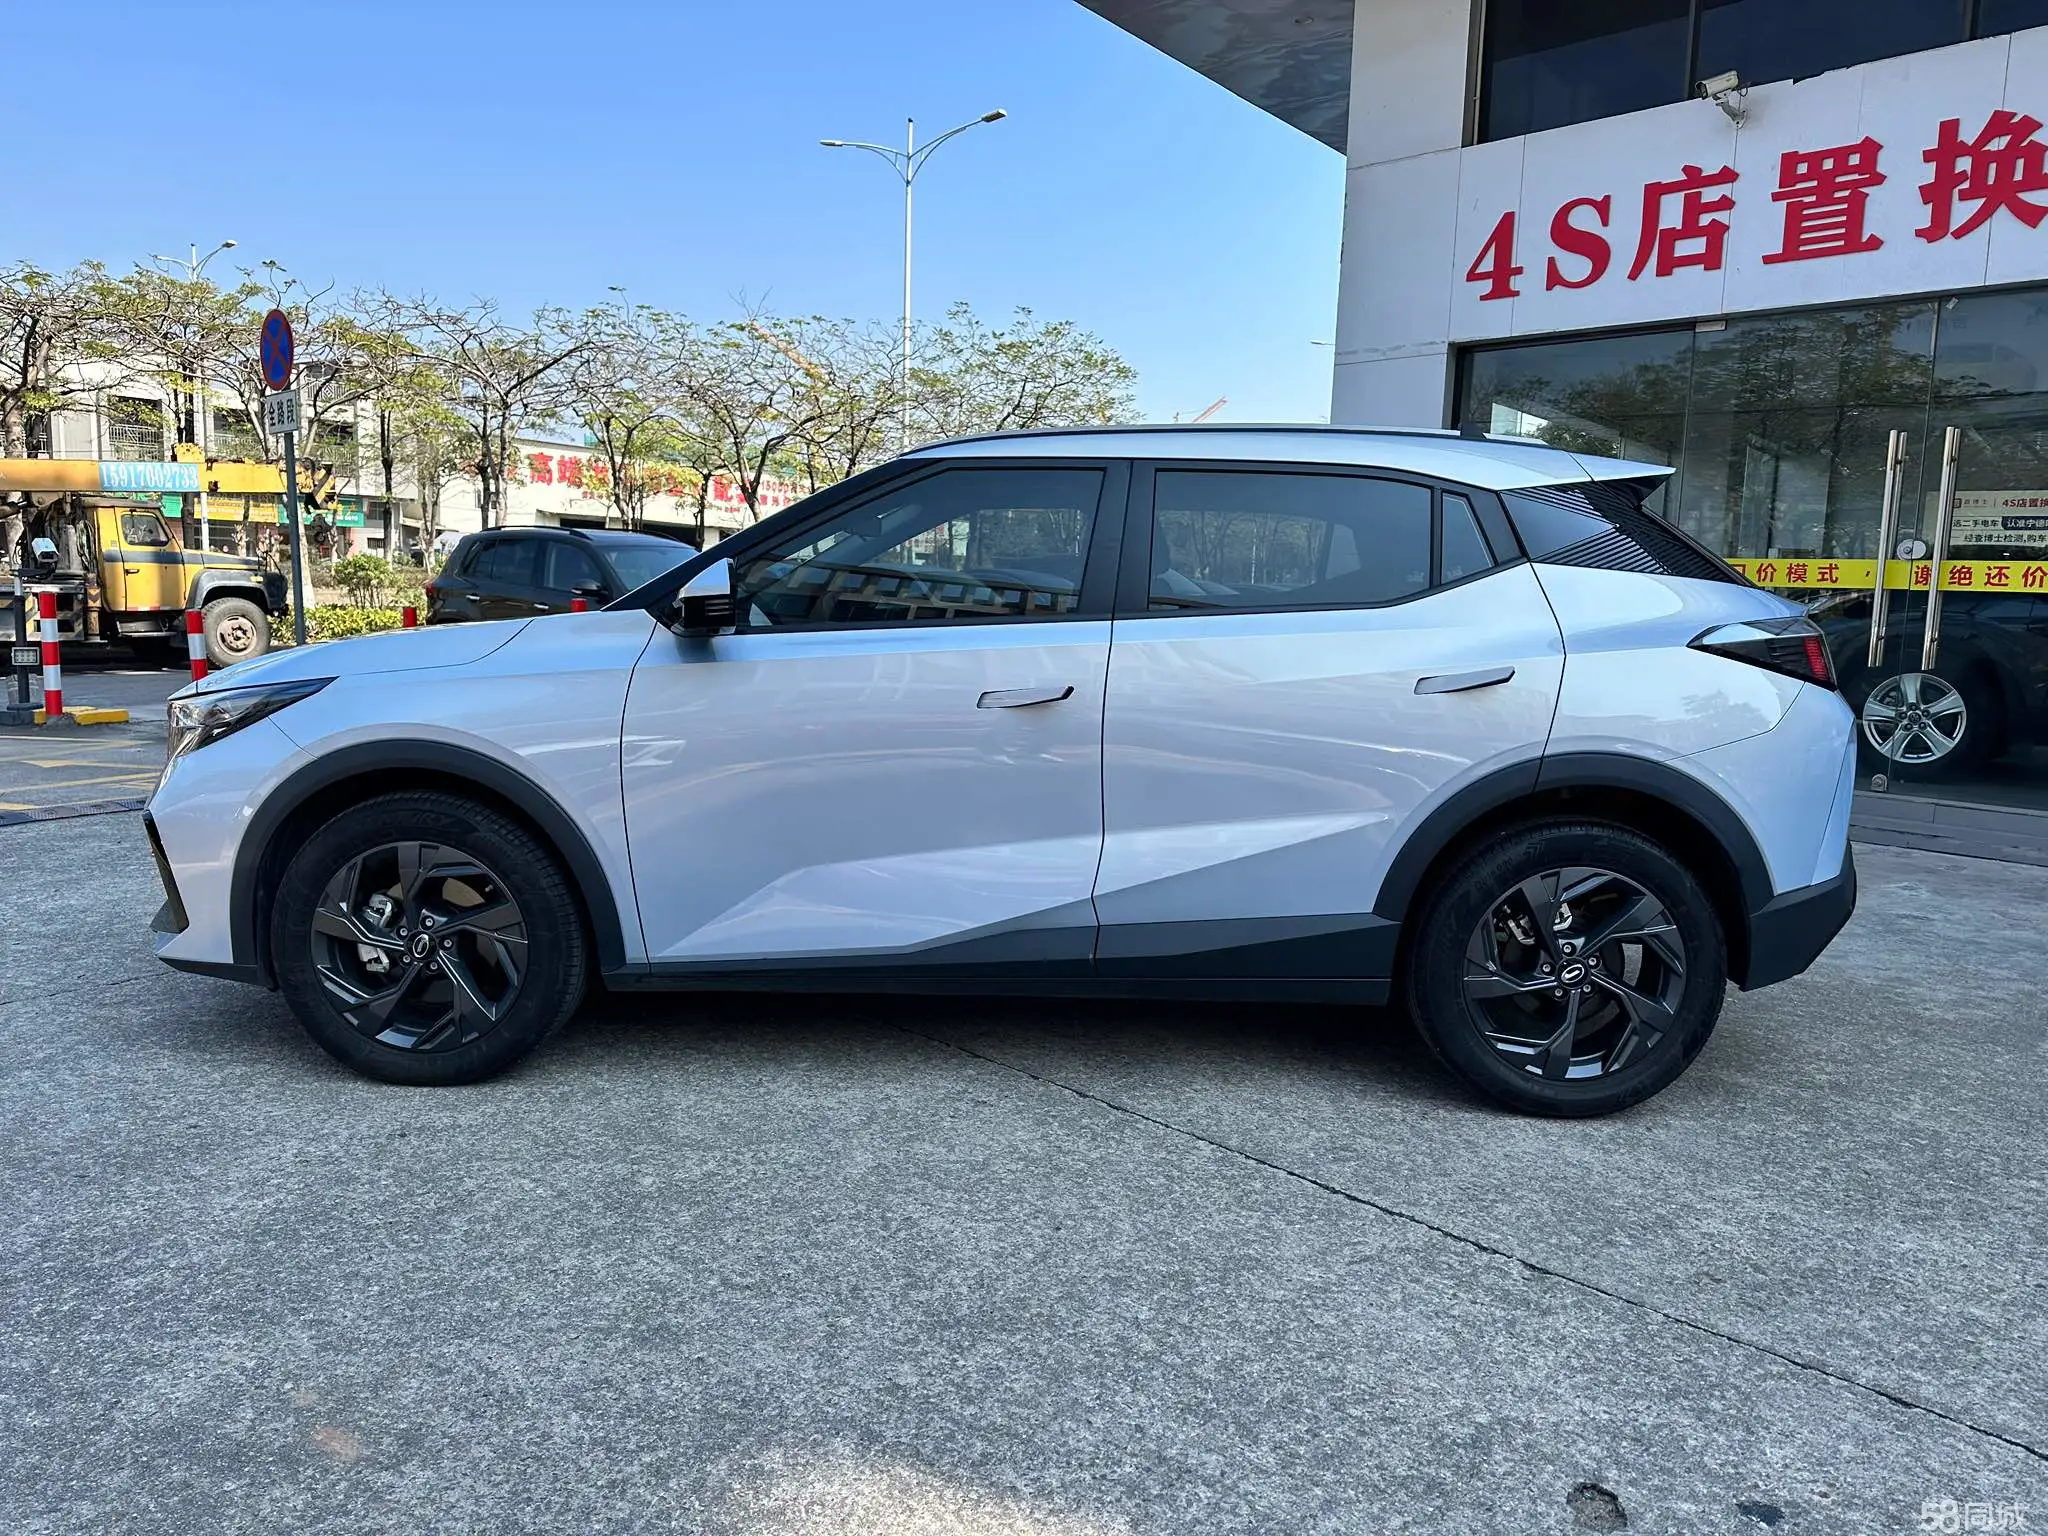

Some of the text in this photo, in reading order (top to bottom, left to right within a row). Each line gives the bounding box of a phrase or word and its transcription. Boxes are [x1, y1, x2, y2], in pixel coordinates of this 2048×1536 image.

[1466, 110, 2048, 301] 4S店置换
[269, 399, 295, 426] 全路段
[2006, 519, 2048, 528] 认准宁德
